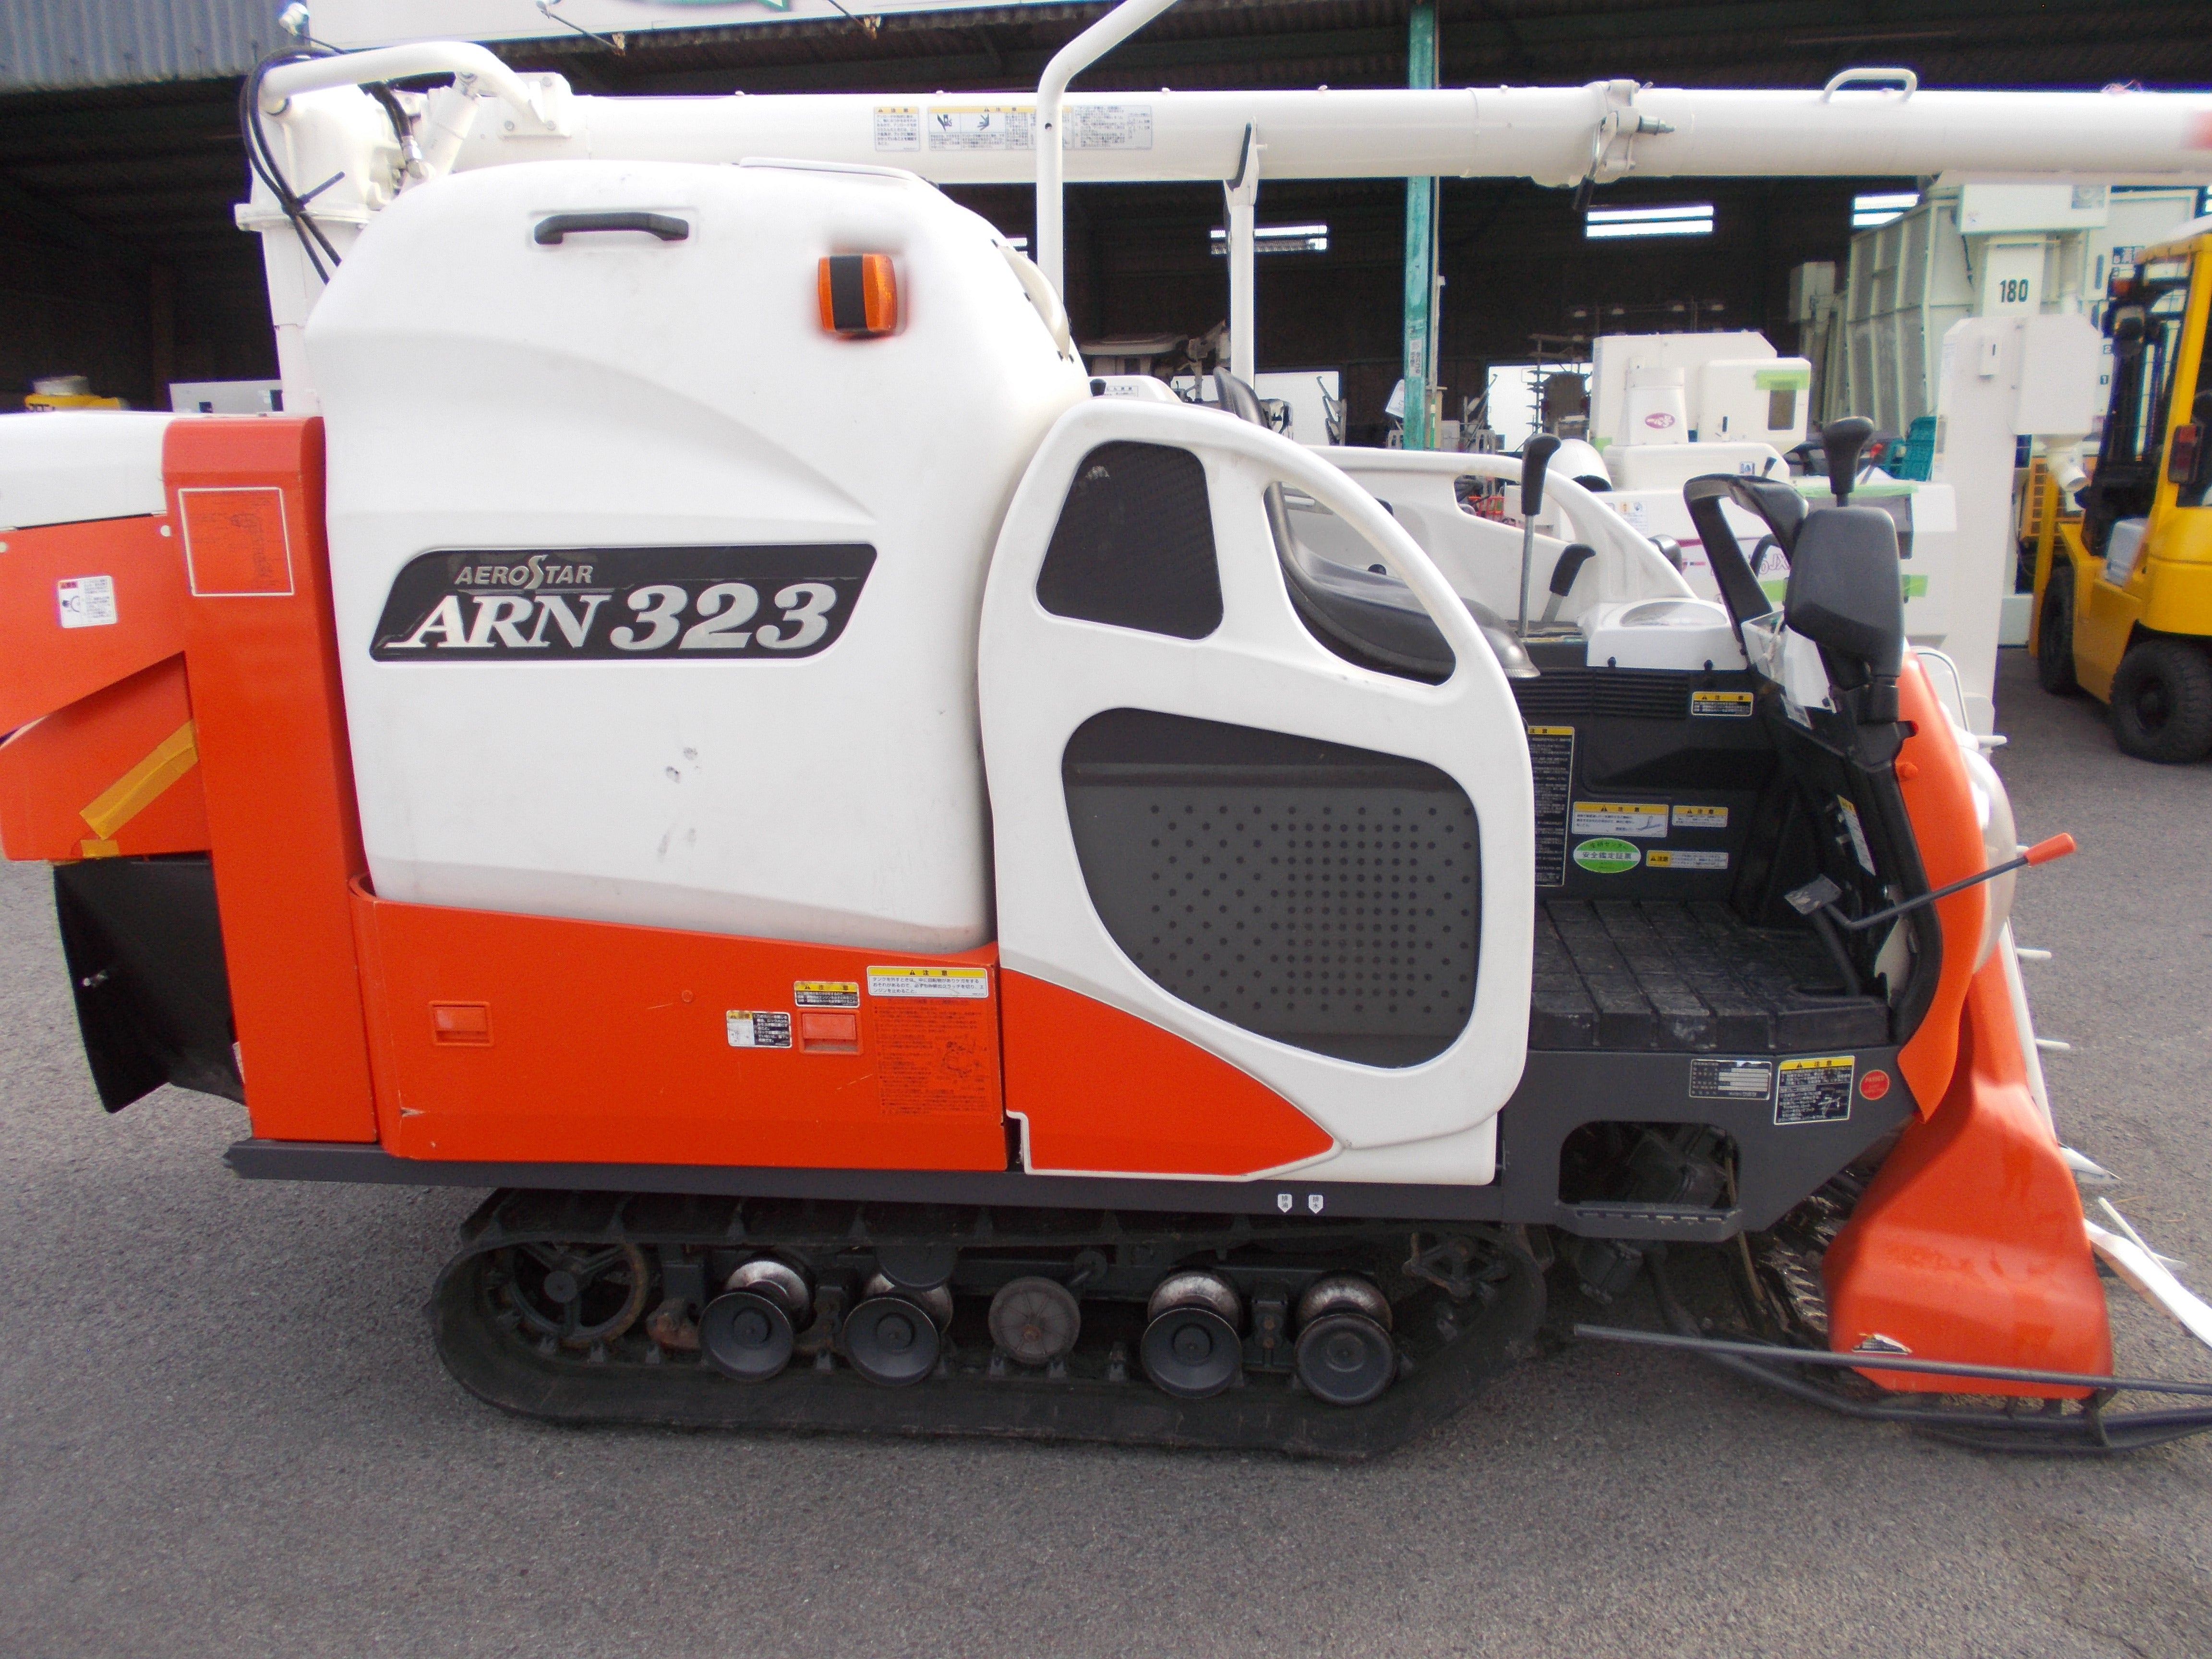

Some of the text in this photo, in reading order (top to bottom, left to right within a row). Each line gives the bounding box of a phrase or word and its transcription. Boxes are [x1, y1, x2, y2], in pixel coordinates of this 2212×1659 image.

[2000, 279, 2029, 302] 180
[454, 554, 593, 589] AEROSTAR
[384, 583, 837, 650] ARN 323
